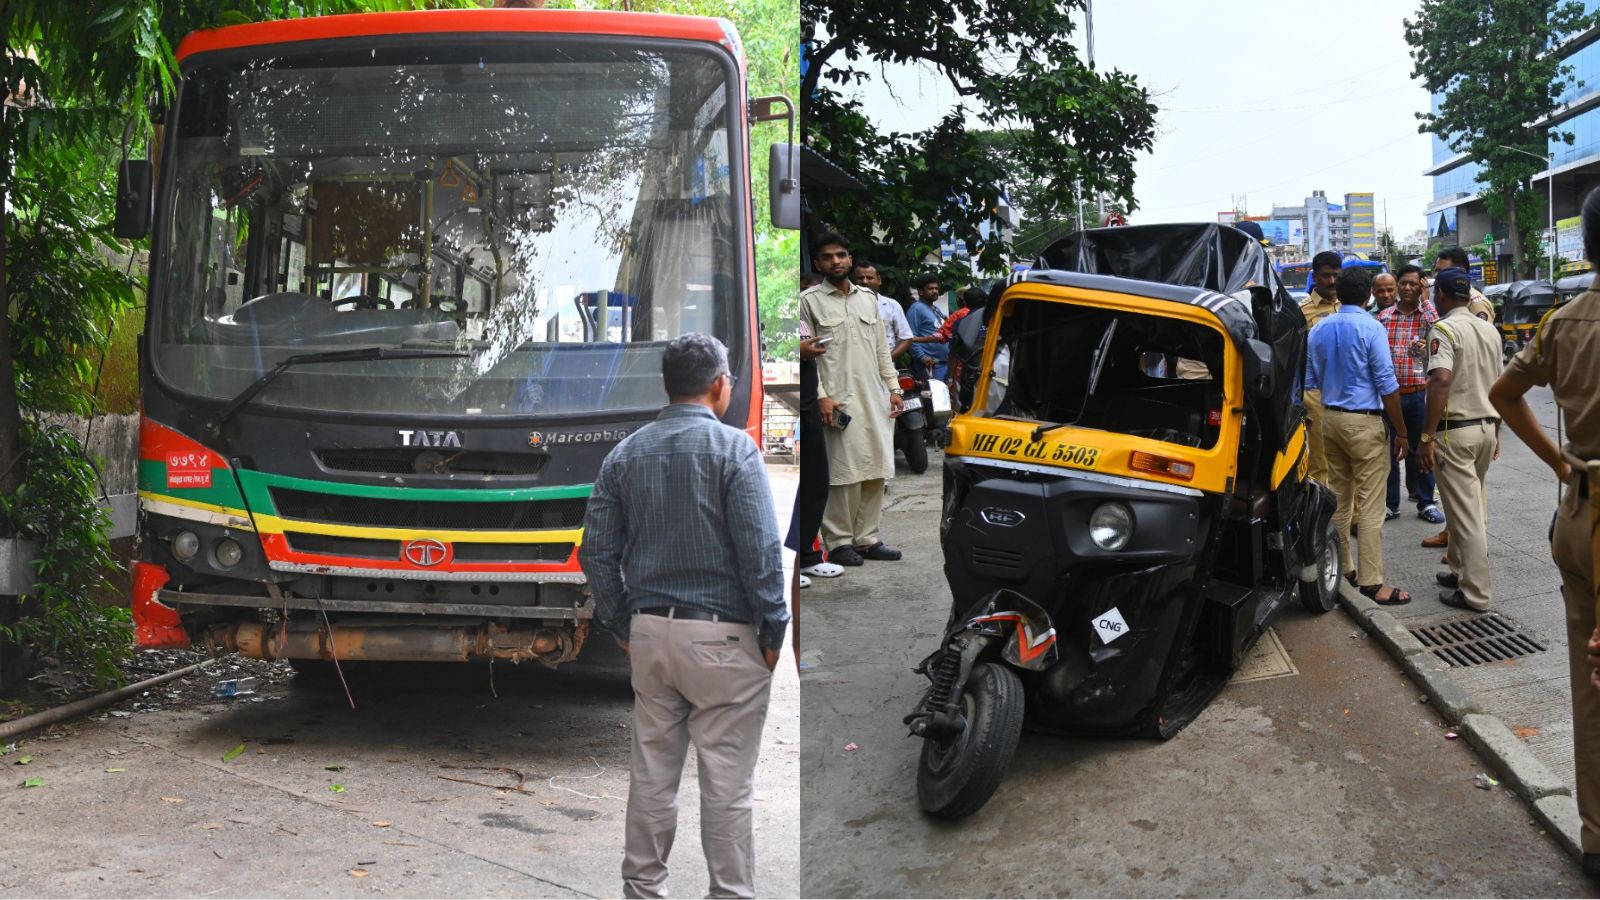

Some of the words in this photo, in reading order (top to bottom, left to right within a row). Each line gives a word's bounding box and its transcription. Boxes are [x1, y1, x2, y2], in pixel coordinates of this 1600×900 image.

[399, 430, 461, 447] TATA
[969, 433, 1000, 452] MH
[1000, 437, 1023, 455] 02
[1024, 440, 1048, 459] GL
[1052, 443, 1098, 466] 5503
[1099, 619, 1122, 632] CNG
